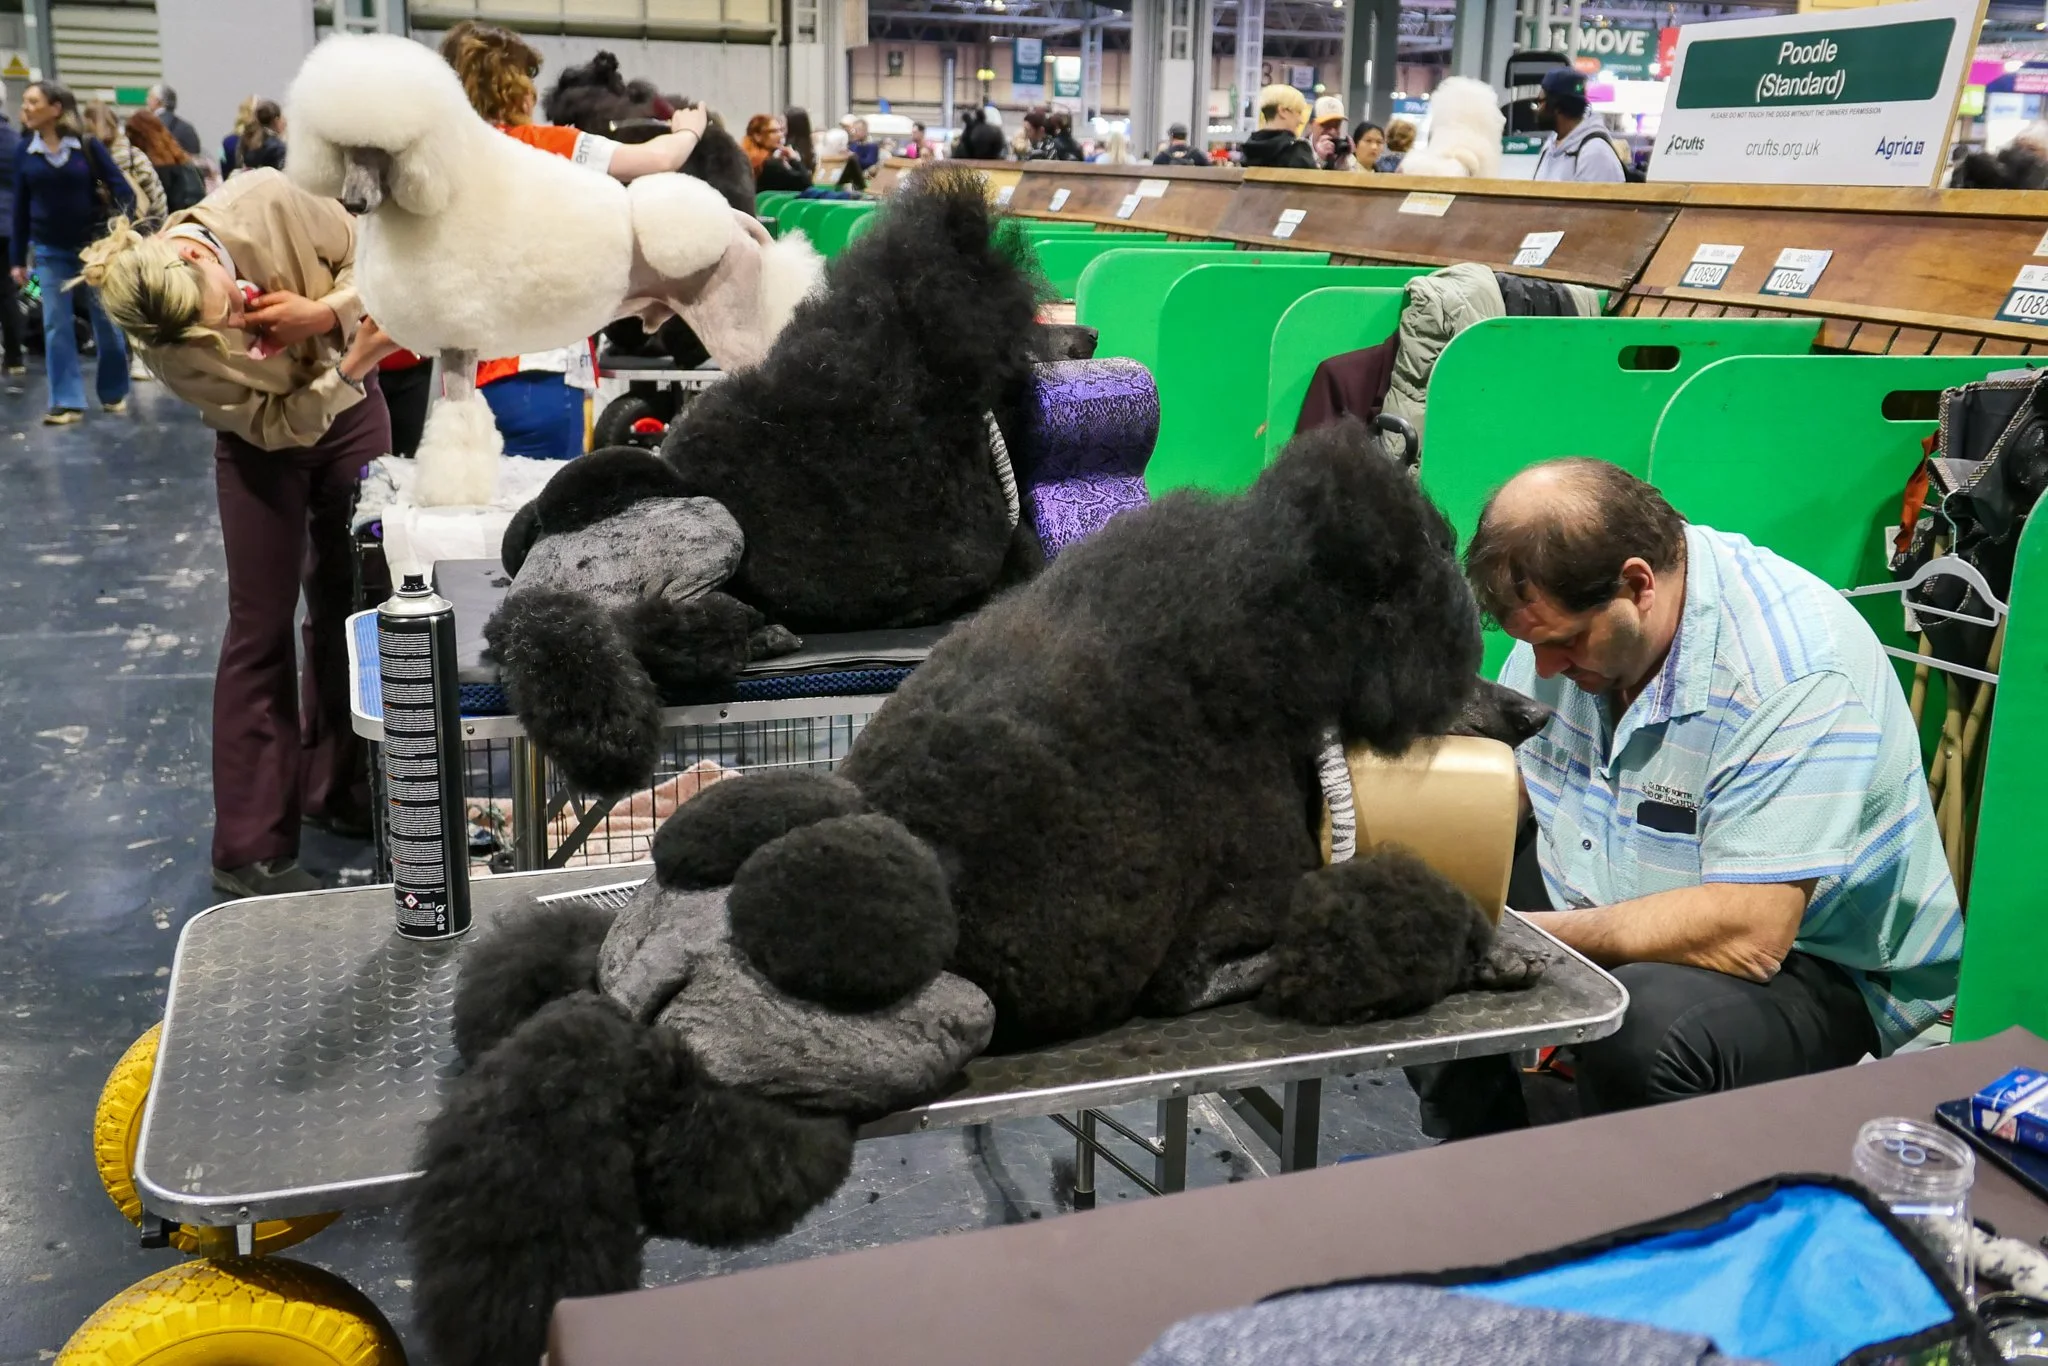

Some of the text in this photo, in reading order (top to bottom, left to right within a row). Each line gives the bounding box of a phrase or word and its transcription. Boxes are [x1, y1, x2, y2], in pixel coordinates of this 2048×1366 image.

[1777, 38, 1838, 65] Poodle
[1755, 69, 1846, 103] (Standard)
[1849, 107, 1882, 115] PERMISSION
[1674, 135, 1705, 151] Crufts
[1745, 139, 1821, 160] crufts.org.uk
[1875, 135, 1913, 160] Agria
[1691, 266, 1724, 283] 10890
